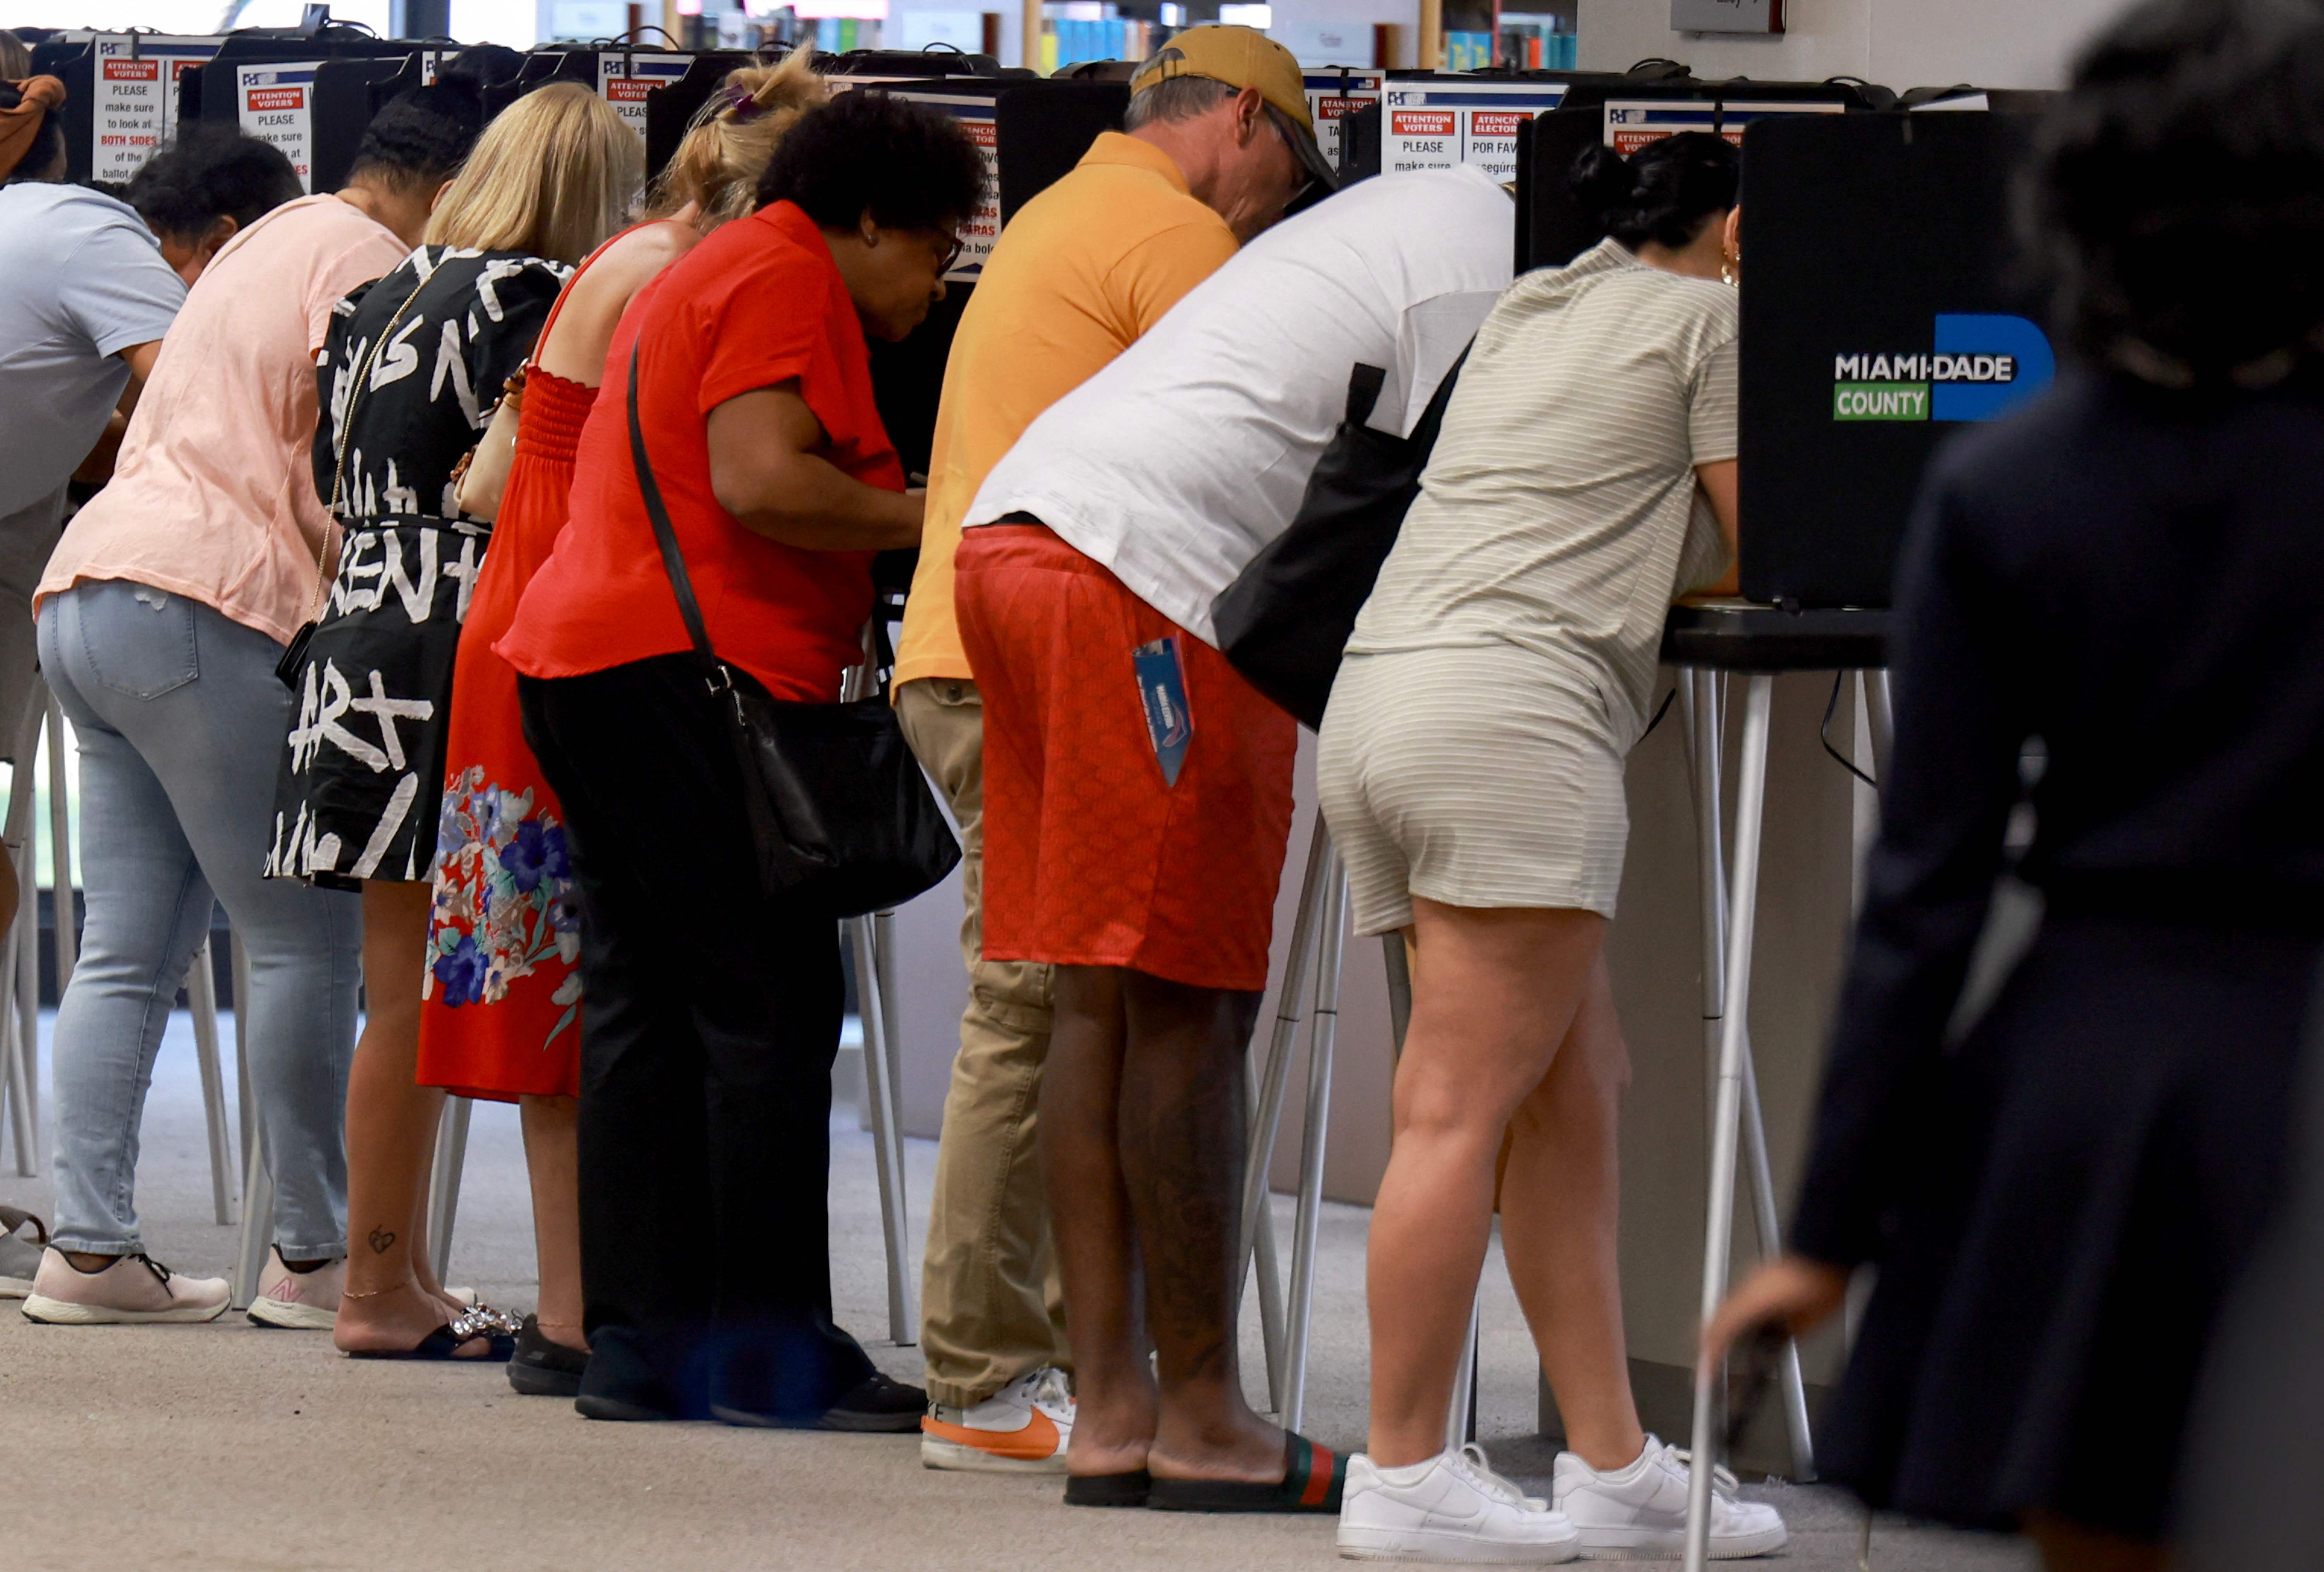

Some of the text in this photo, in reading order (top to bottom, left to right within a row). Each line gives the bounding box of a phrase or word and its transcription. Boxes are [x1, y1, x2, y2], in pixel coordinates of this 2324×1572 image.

[113, 86, 148, 95] PLEASE
[251, 91, 300, 100] ATTENTION
[105, 103, 154, 112] make sure
[258, 99, 293, 108] VOTERS
[617, 107, 646, 117] PLEAS
[258, 114, 294, 125] PLEASE
[1394, 115, 1451, 123] ATTENTION
[1477, 115, 1521, 124] ATENCIÓ
[108, 119, 151, 129] to look at
[1403, 124, 1443, 132] VOTERS
[1475, 125, 1517, 133] ELECTOR
[101, 136, 157, 146] BOTH SIDES
[281, 133, 303, 141] sure
[1403, 142, 1443, 153] PLEASE
[1473, 142, 1517, 153] POR FAV
[115, 153, 141, 162] of the
[291, 149, 301, 158] at
[103, 169, 128, 179] ballot
[1837, 392, 1925, 415] COUNTY
